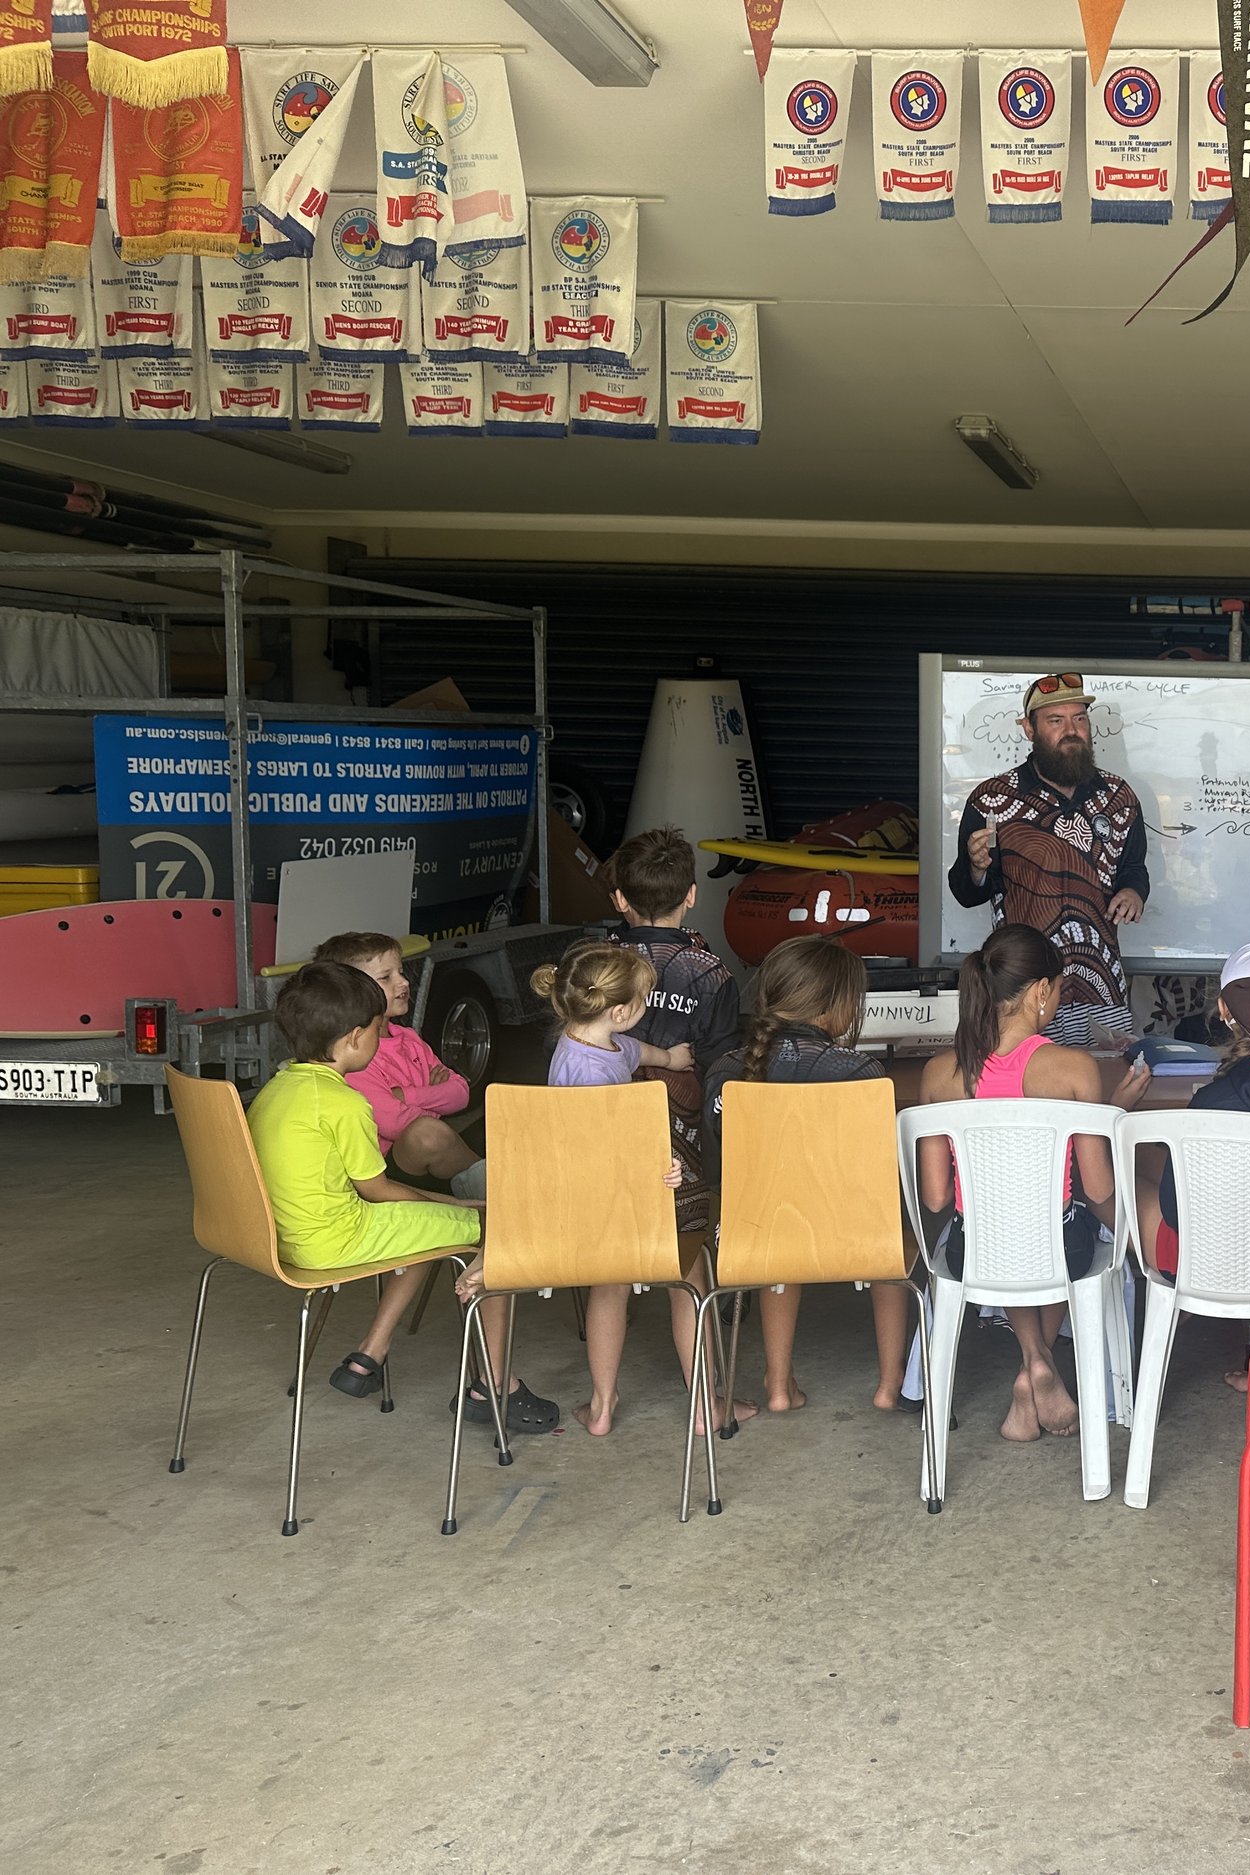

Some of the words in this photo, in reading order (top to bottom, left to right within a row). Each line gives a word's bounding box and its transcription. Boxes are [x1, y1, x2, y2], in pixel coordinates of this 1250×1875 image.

[116, 8, 221, 37] CHAMPIONSHIPS
[126, 24, 158, 37] PORT
[161, 26, 192, 42] 1972
[1234, 31, 1242, 51] RACE
[295, 73, 316, 84] LIFE
[276, 119, 297, 143] SOUTH
[801, 155, 826, 164] SECOND
[909, 158, 935, 166] FIRST
[1017, 157, 1042, 165] FIRST
[1121, 154, 1147, 162] FIRST
[568, 212, 586, 220] LIFE
[211, 281, 238, 289] MASTERS
[128, 296, 158, 310] FIRST
[237, 296, 270, 311] SECOND
[341, 300, 382, 313] SECOND
[56, 375, 80, 386] THIRD
[327, 379, 350, 391] THIRD
[432, 384, 452, 395] THIRD
[607, 383, 626, 394] FIRST
[698, 387, 724, 397] SECOND
[983, 678, 1021, 693] Saving
[1090, 681, 1138, 692] WATER
[1147, 683, 1190, 697] CYCLE
[343, 736, 370, 748] 8543
[375, 737, 401, 749] 8341
[404, 738, 424, 750] Call
[431, 739, 447, 751] Club
[127, 758, 231, 775] SEMAPHORE
[257, 761, 308, 777] LARGS
[313, 762, 332, 777] TO
[337, 762, 400, 778] PATROLS
[405, 763, 445, 779] ROVING
[448, 764, 466, 778] WITH
[489, 764, 498, 775] TO
[500, 763, 528, 775] OCTOBER
[736, 758, 760, 816] NORTH
[248, 793, 321, 813] PUBLIC
[328, 793, 369, 813] AND
[375, 793, 454, 813] WEEKENDS
[456, 796, 474, 811] THE
[476, 795, 488, 809] ON
[490, 788, 528, 808] PATROLS
[299, 838, 336, 859] 042
[459, 860, 470, 876] 21
[473, 851, 524, 874] CENTURY
[864, 1005, 936, 1024] TRAININ
